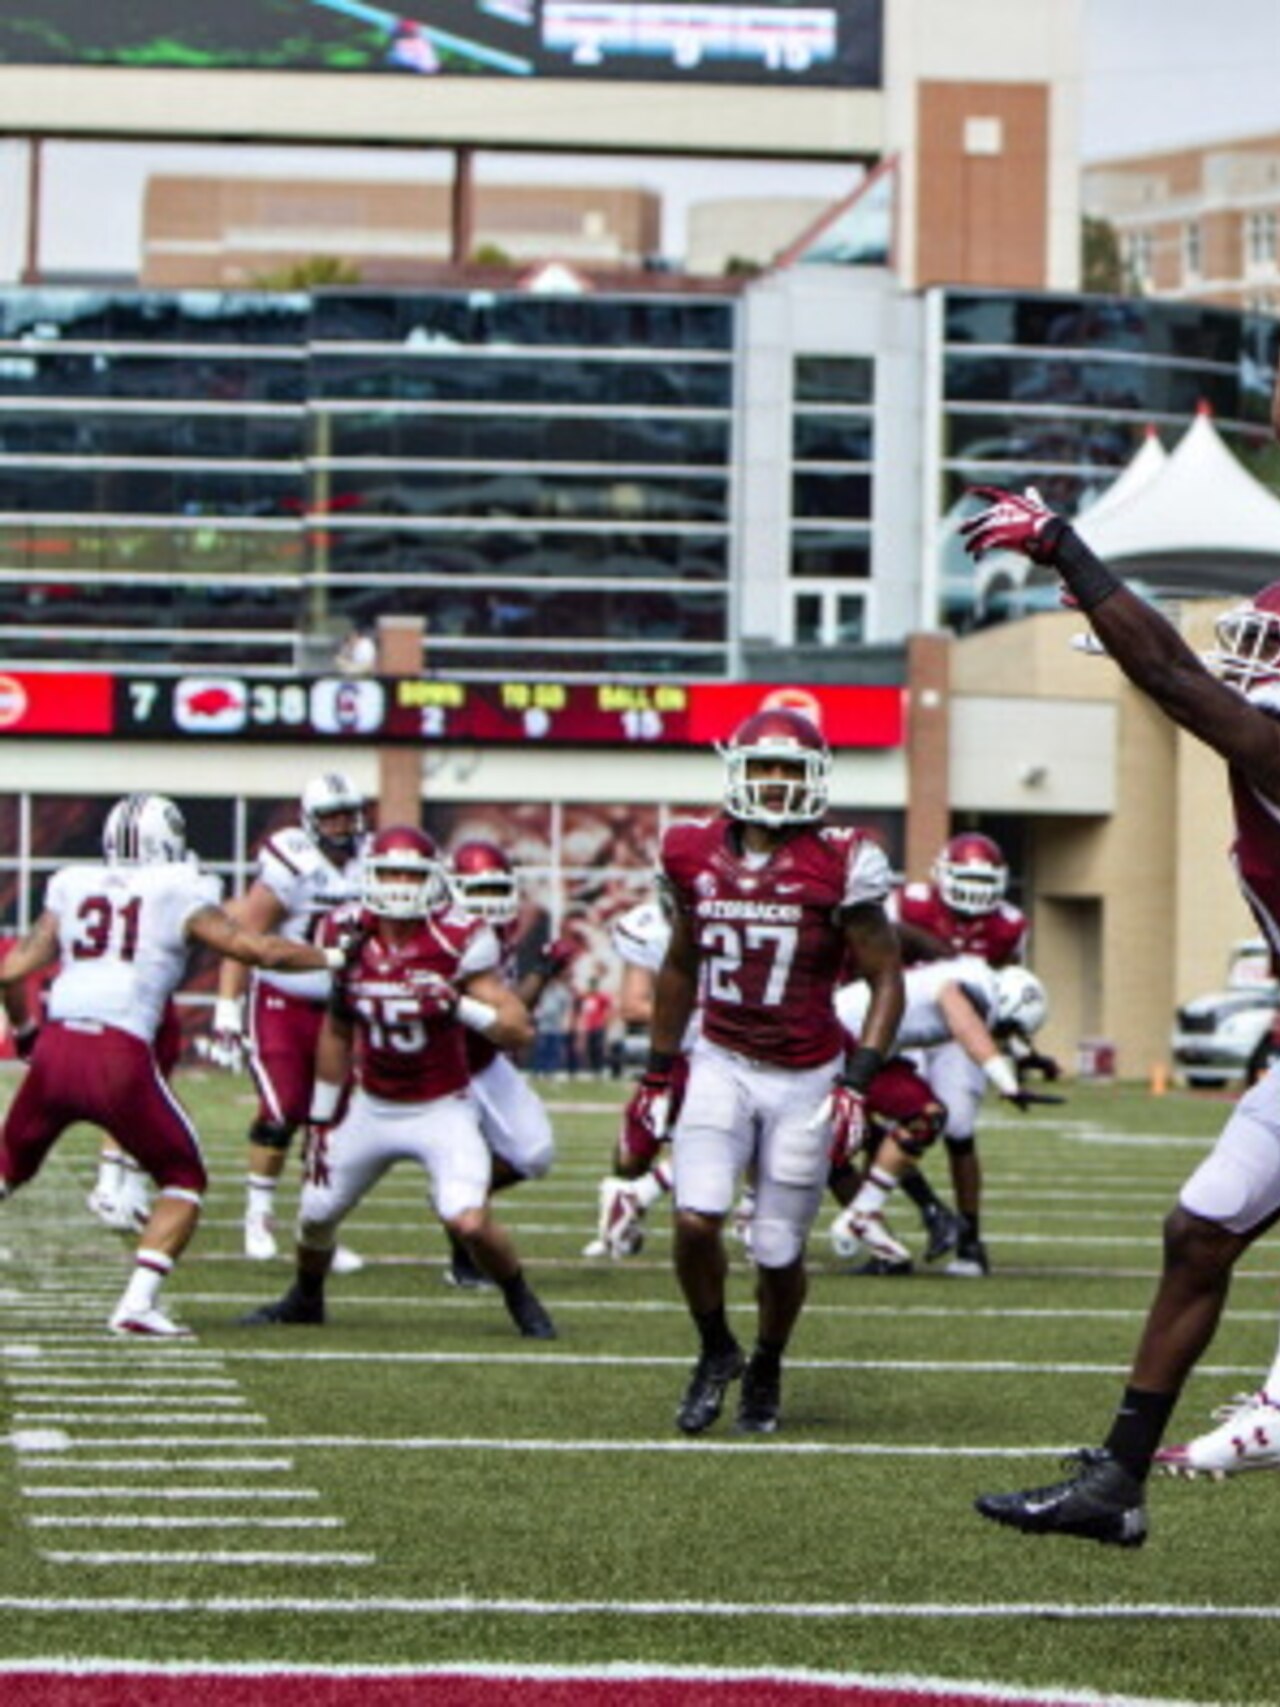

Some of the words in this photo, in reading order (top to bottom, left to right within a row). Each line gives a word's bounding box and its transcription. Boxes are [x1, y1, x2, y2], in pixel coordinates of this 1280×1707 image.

[129, 682, 158, 721] 7
[421, 706, 445, 737] 2
[72, 895, 143, 962] 31
[701, 923, 799, 1005] 27
[356, 998, 427, 1052] 15
